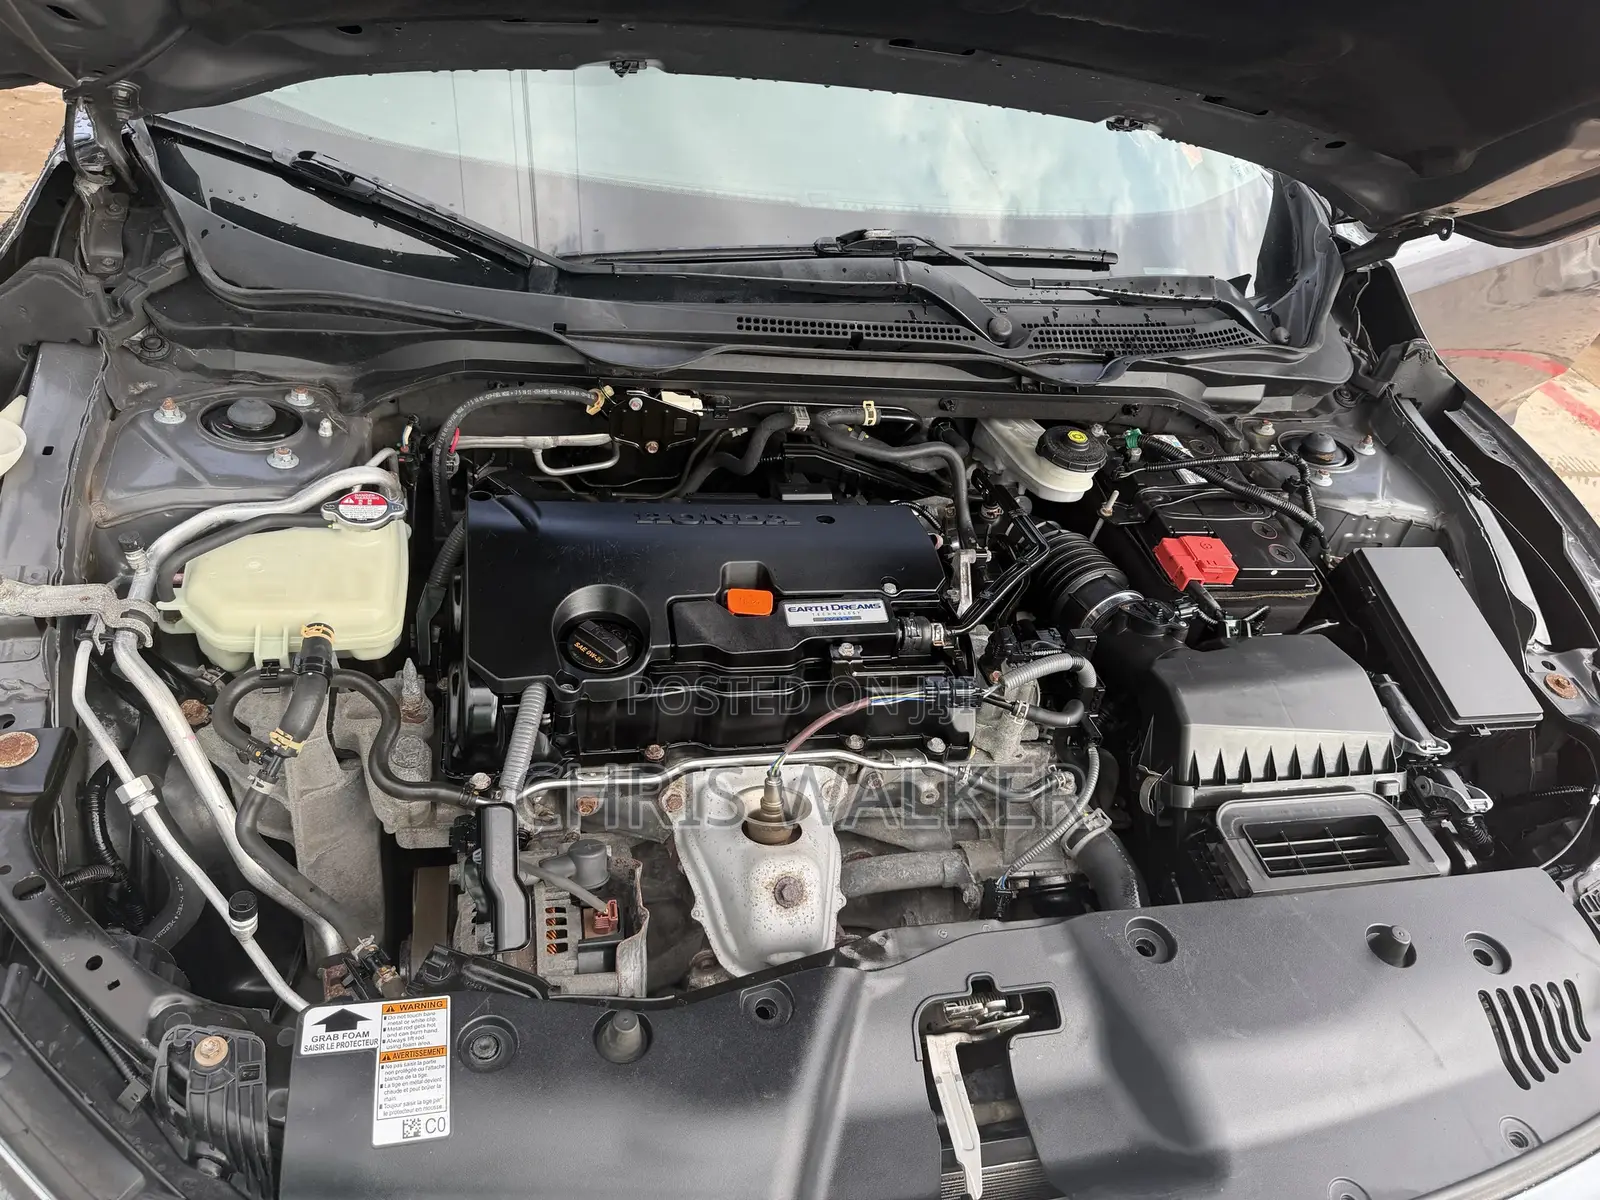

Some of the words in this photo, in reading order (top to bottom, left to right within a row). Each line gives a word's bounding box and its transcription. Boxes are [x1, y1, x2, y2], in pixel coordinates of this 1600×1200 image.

[634, 512, 800, 526] HONDA
[574, 642, 588, 652] SAE
[400, 1001, 443, 1010] WARNING
[311, 1033, 339, 1043] GRAB
[342, 1031, 370, 1040] FOAM
[304, 1043, 325, 1052] SAISIR
[335, 1038, 379, 1049] PROTECTEUR
[393, 1048, 444, 1059] AVERTISSEMENT
